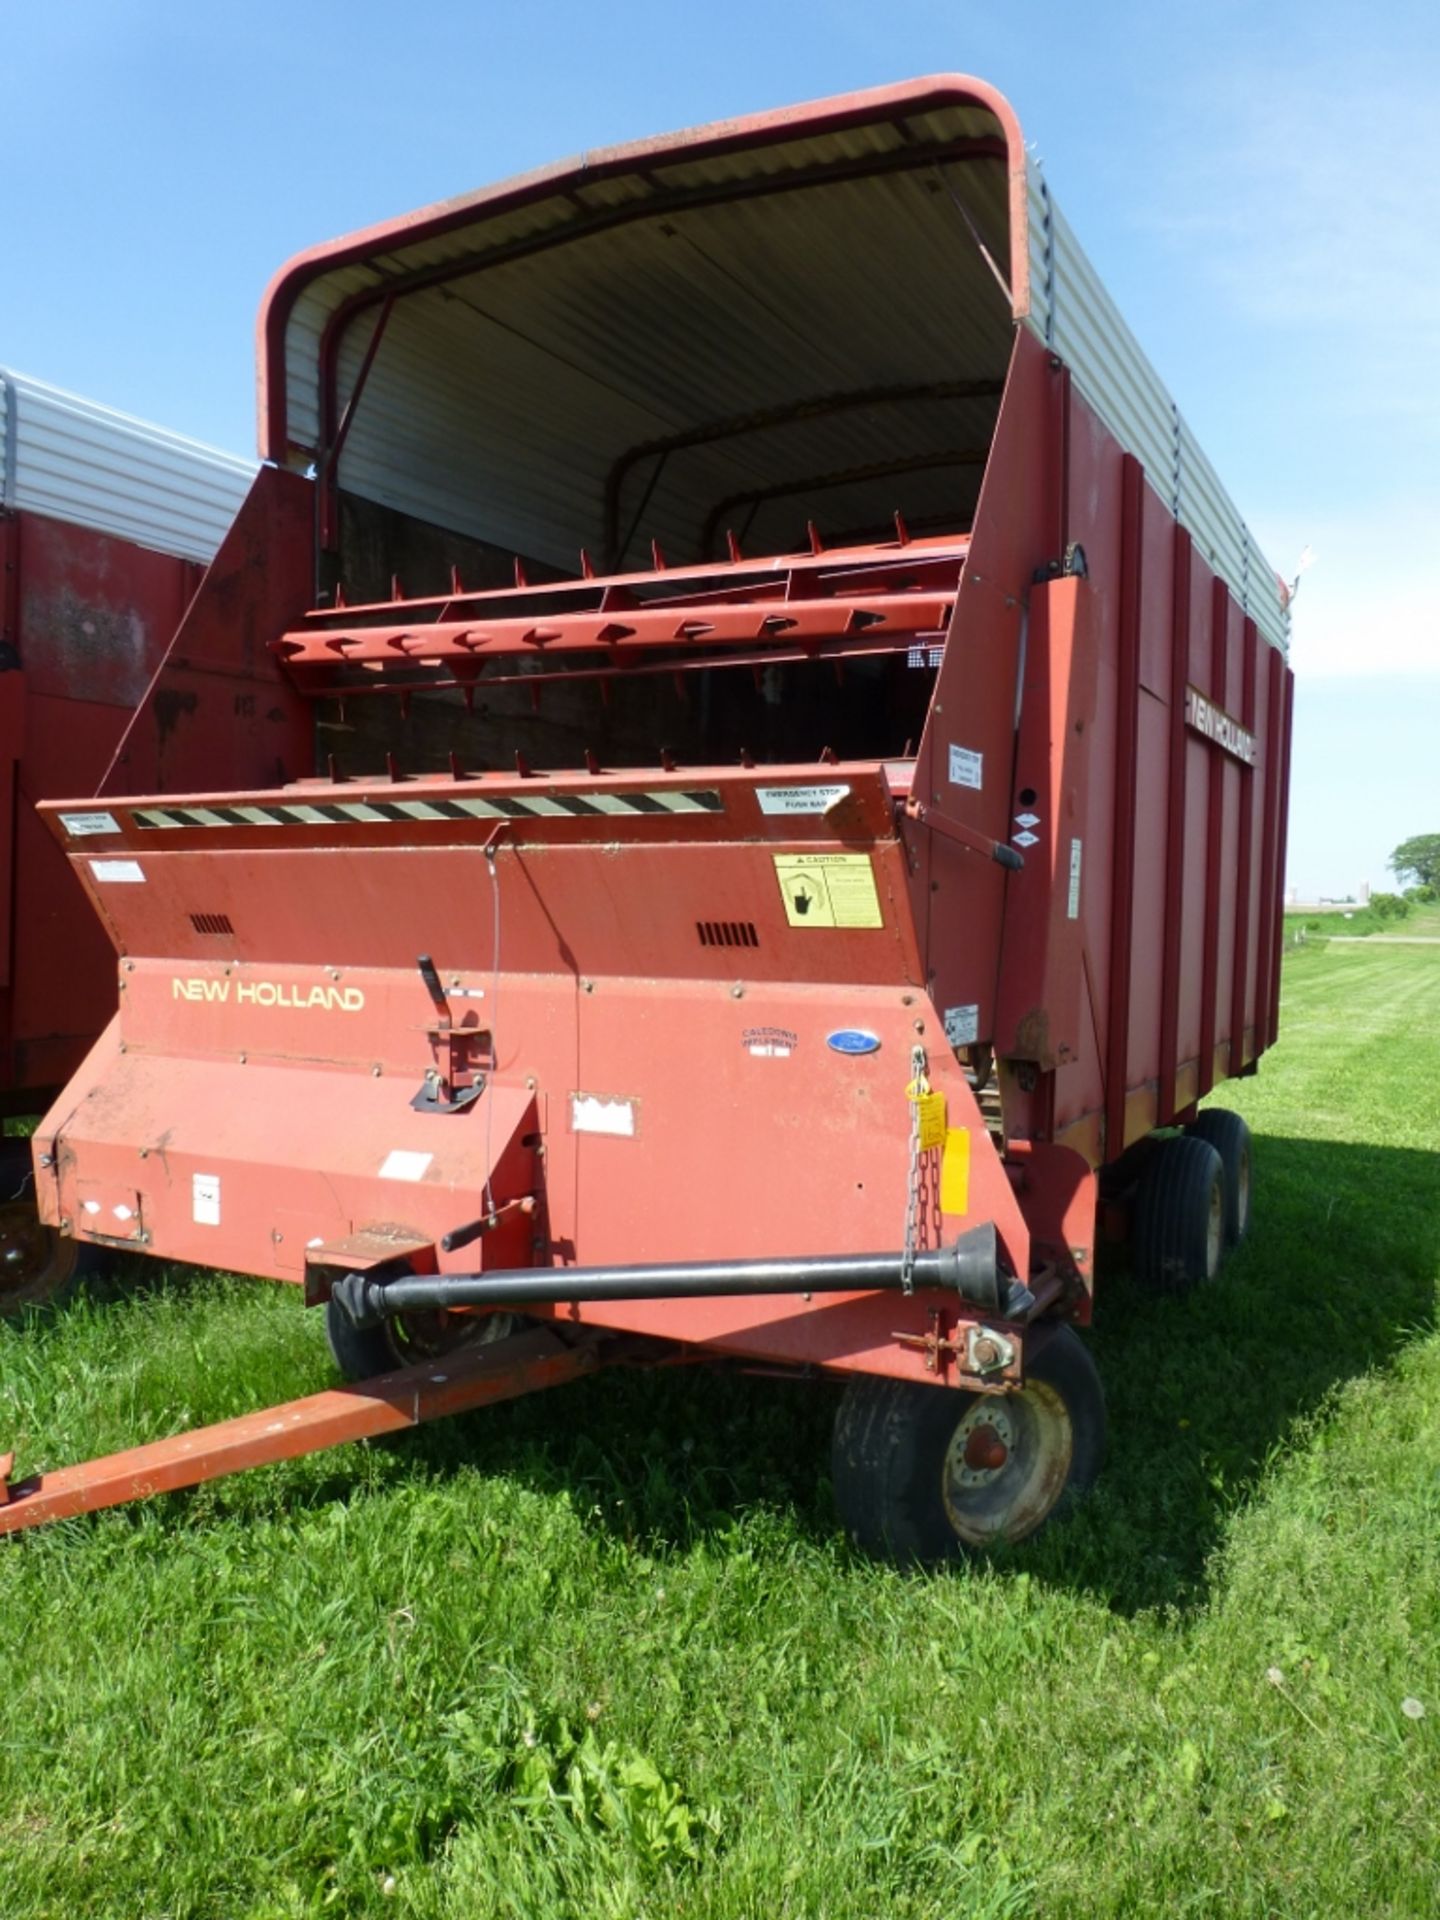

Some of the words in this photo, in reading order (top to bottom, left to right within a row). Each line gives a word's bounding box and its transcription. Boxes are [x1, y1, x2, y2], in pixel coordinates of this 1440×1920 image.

[1191, 693, 1213, 739] NEW
[1213, 708, 1251, 761] HOLLAND
[765, 789, 817, 798] EMERGENCY
[819, 787, 840, 796] STOP
[172, 978, 230, 1002] NEW
[237, 981, 365, 1011] HOLLAND
[742, 1027, 797, 1041] CALEDONIA
